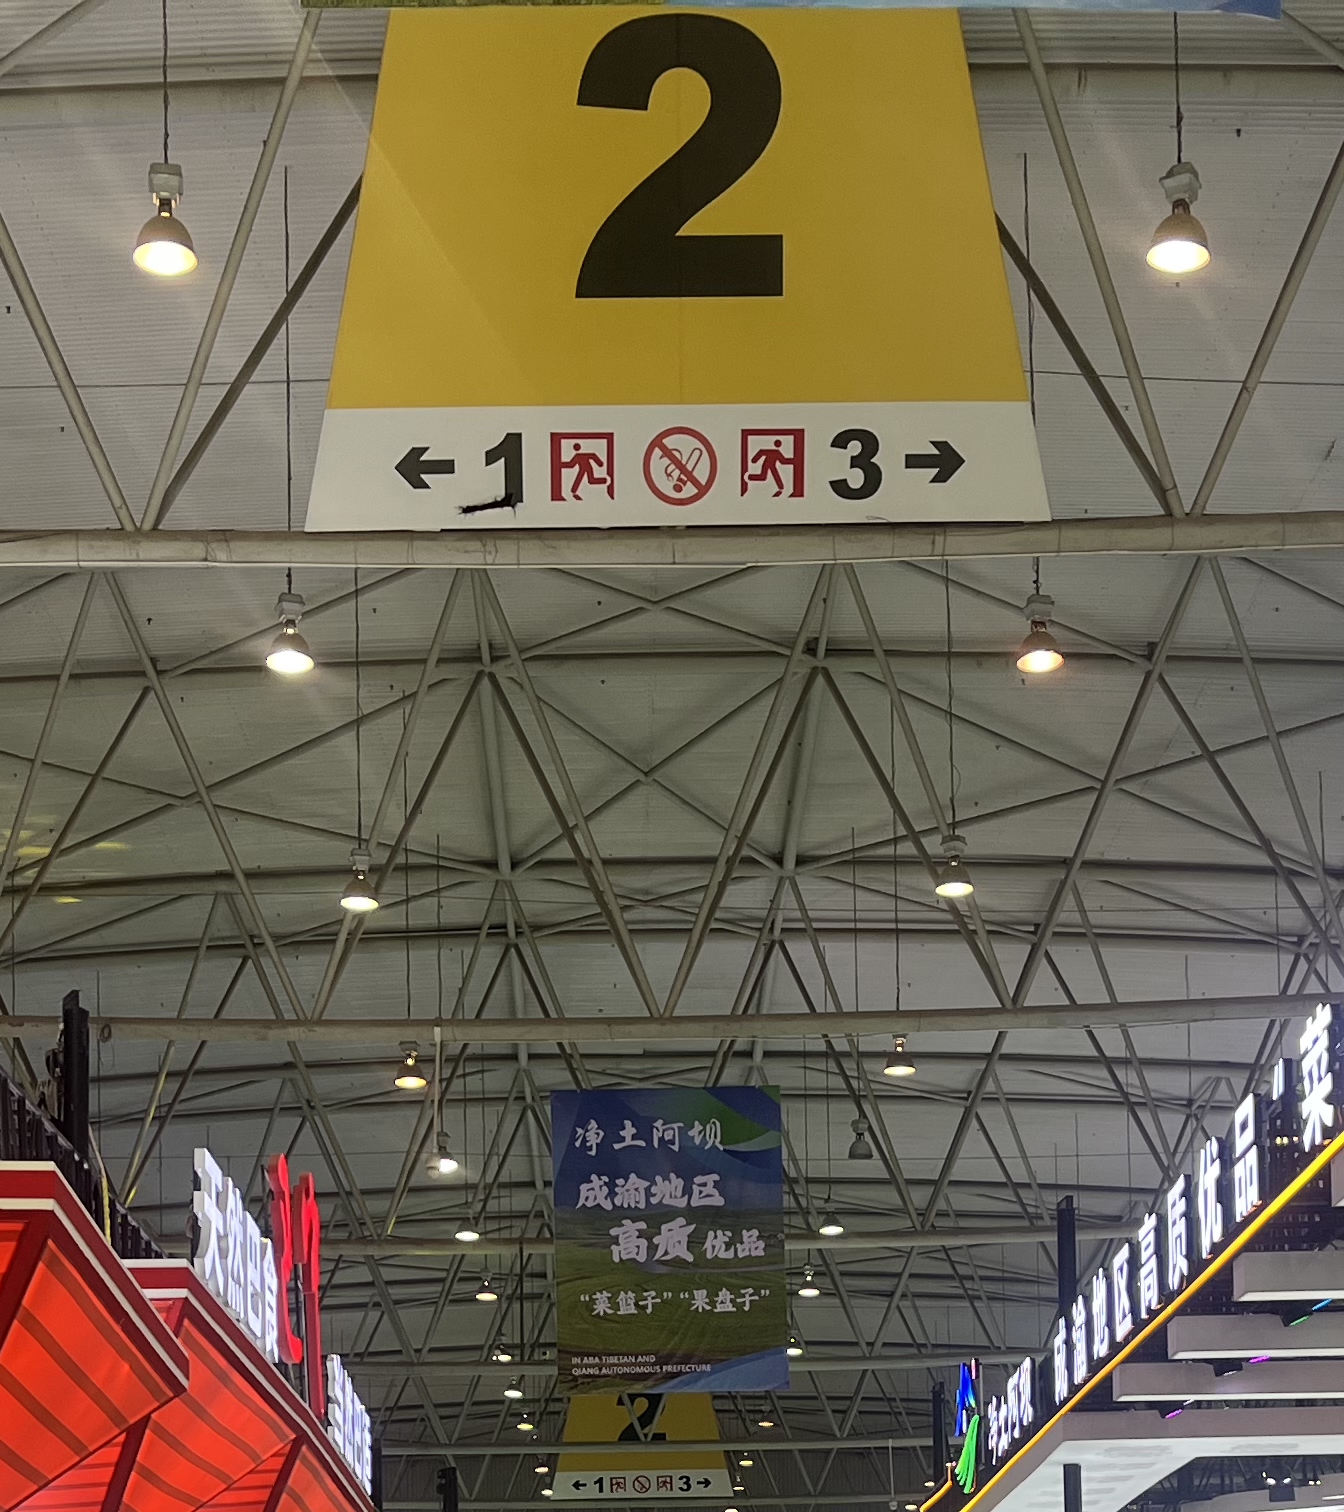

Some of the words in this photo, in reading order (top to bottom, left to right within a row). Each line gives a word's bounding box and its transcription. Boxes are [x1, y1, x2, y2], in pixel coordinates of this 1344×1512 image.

[576, 13, 784, 299] 2
[484, 431, 525, 504] 1
[829, 428, 883, 501] 3
[574, 1117, 725, 1156] 净土阿坝
[575, 1172, 725, 1211] 成渝地区
[571, 1356, 582, 1364] IN
[582, 1355, 600, 1364] ABA
[601, 1355, 636, 1363] TIBETAN
[637, 1354, 656, 1363] AND
[571, 1366, 600, 1376] QIANG
[601, 1365, 661, 1374] AUTONOMOUS
[662, 1363, 712, 1373] PREFECTURE
[593, 1476, 605, 1494] 1
[678, 1475, 692, 1492] 3
